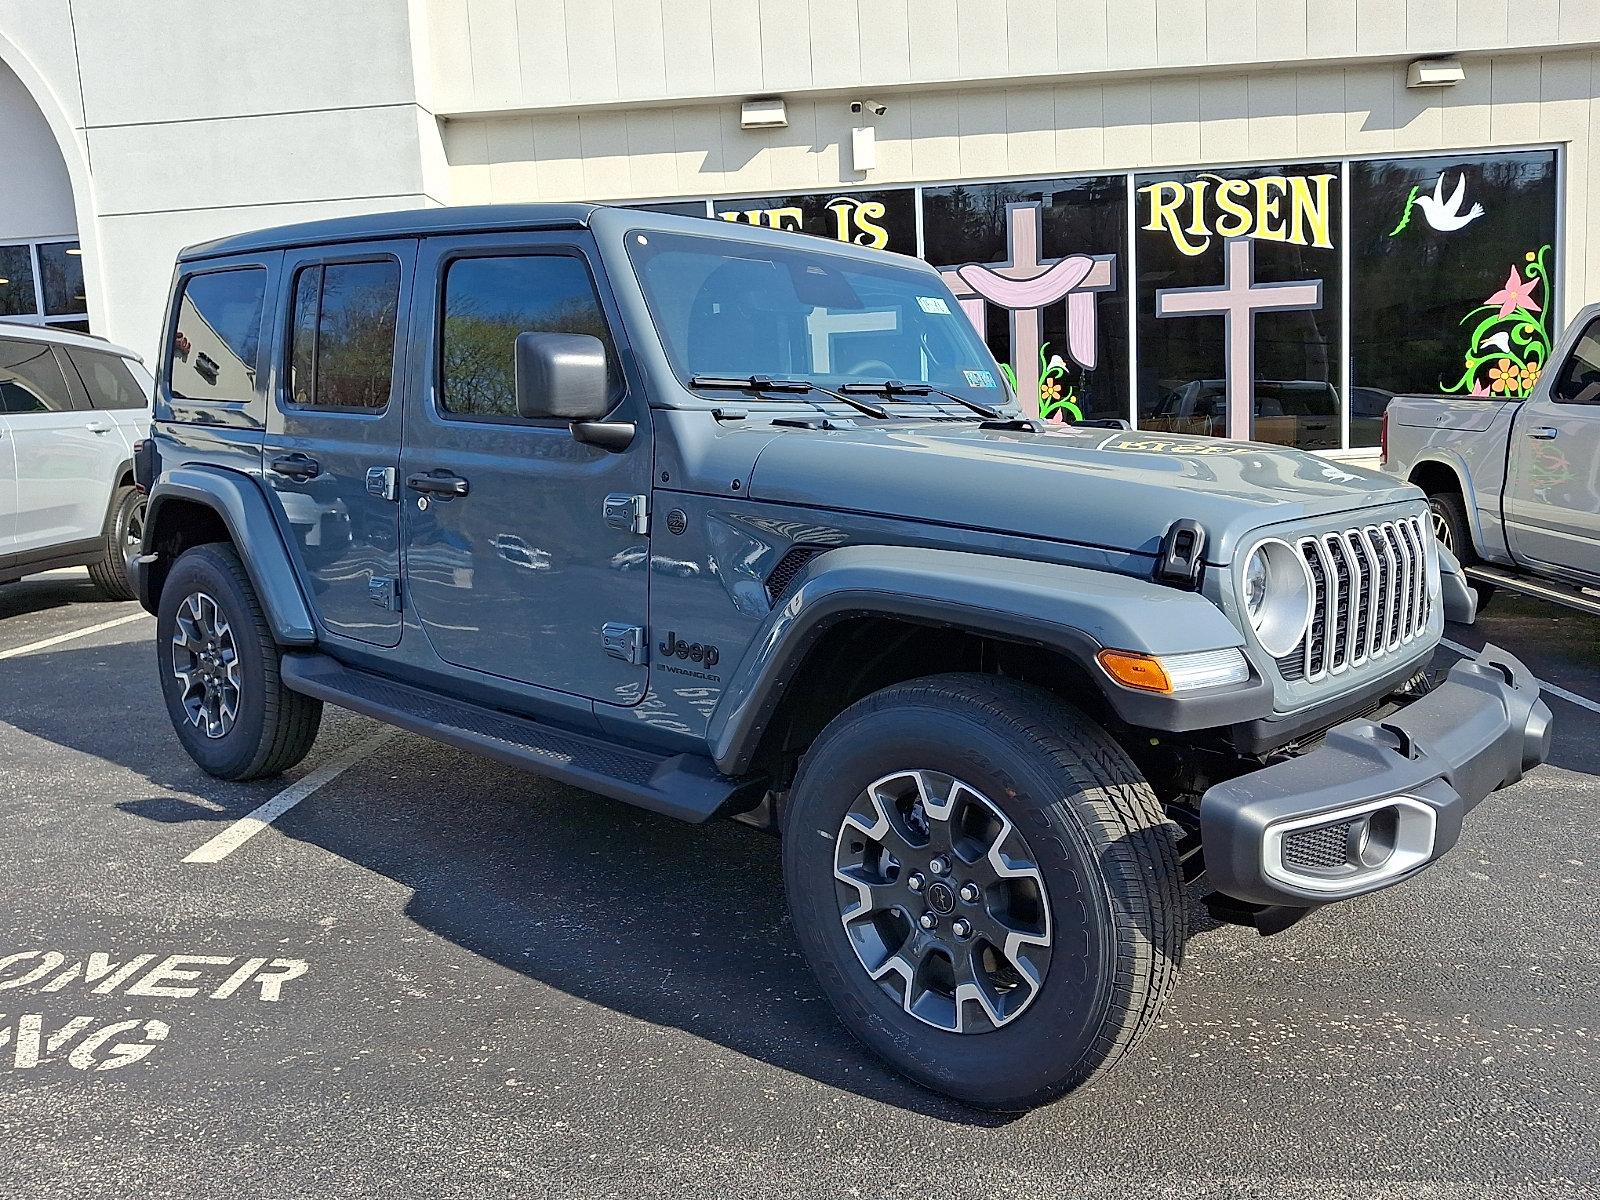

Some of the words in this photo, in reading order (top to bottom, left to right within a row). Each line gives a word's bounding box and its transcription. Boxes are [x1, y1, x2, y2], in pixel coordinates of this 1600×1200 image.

[824, 197, 889, 250] IS
[1136, 174, 1338, 256] RISEN
[659, 631, 719, 669] Jeep
[665, 665, 721, 683] WRANGLER
[0, 1013, 171, 1072] NG
